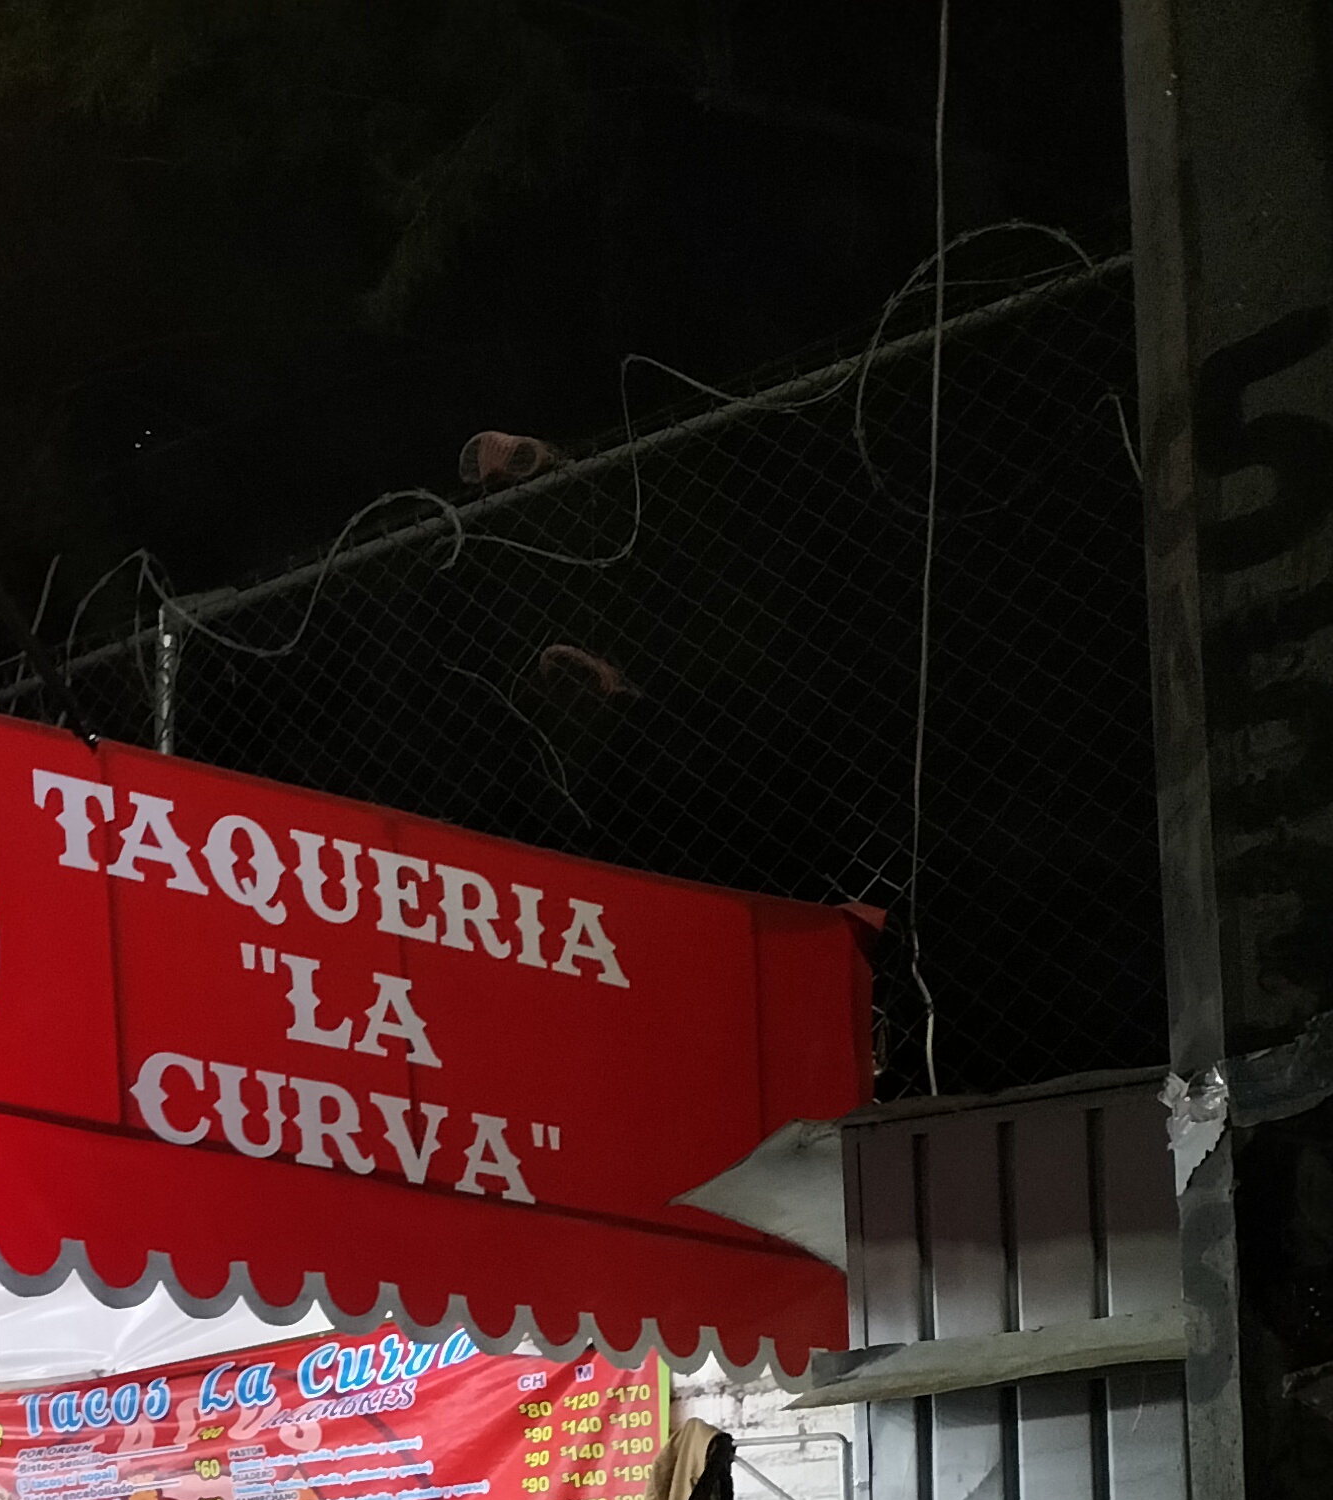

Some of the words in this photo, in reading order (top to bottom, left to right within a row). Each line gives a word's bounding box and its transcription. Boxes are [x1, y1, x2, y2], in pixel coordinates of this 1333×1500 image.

[32, 767, 630, 990] TAQUERIA
[240, 943, 443, 1070] "LA
[130, 1051, 562, 1205] CURVA"
[18, 1377, 171, 1436] Tacos
[199, 1361, 276, 1414] La
[297, 1330, 479, 1398] Curva
[519, 1373, 545, 1390] CH
[576, 1364, 593, 1380] M
[519, 1401, 553, 1418] $80
[564, 1391, 600, 1410] $120
[606, 1384, 650, 1403] $170
[524, 1425, 552, 1443] $90
[561, 1416, 602, 1435] $140
[609, 1410, 652, 1429] $190
[524, 1450, 550, 1467] $90
[560, 1442, 605, 1462] $140
[612, 1437, 654, 1456] $190
[194, 1459, 221, 1479] $60
[522, 1475, 550, 1493] $90
[562, 1469, 607, 1488] $140
